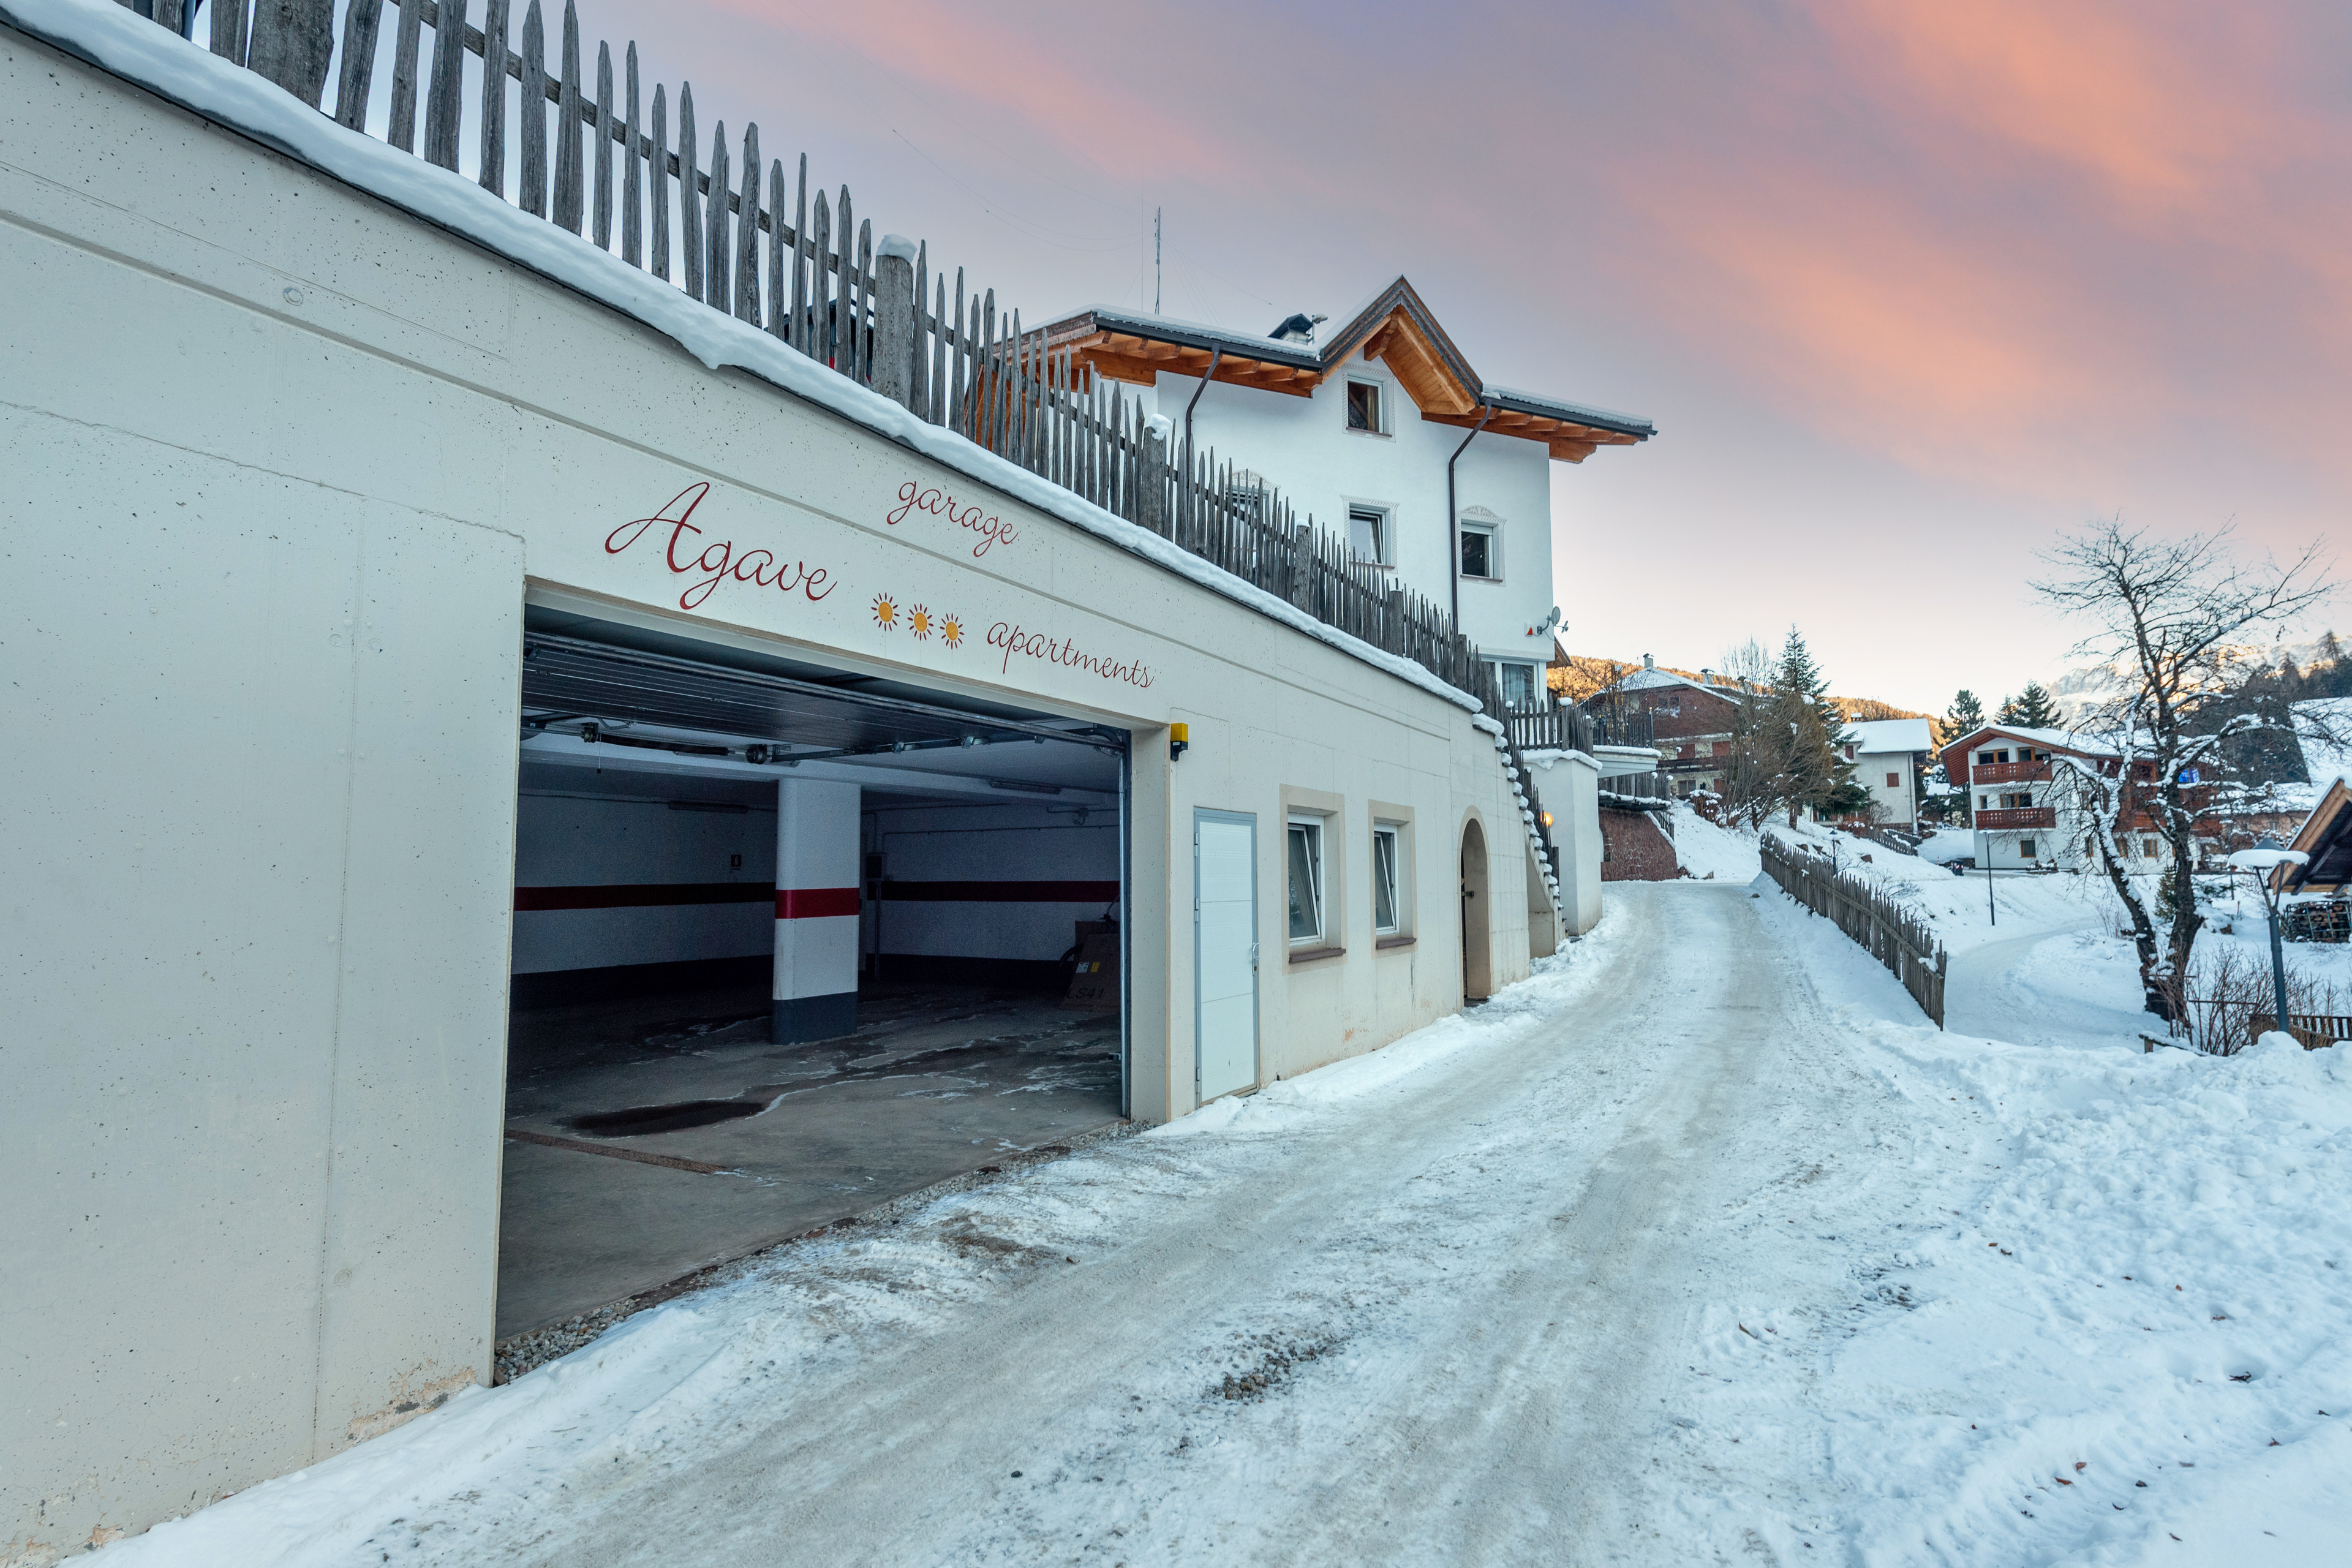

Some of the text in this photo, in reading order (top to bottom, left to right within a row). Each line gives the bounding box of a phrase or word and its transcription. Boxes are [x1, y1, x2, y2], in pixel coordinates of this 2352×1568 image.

[605, 481, 838, 611] Agave
[886, 481, 1018, 557] garage
[987, 622, 1155, 688] apartments
[1066, 987, 1104, 999] LS41
